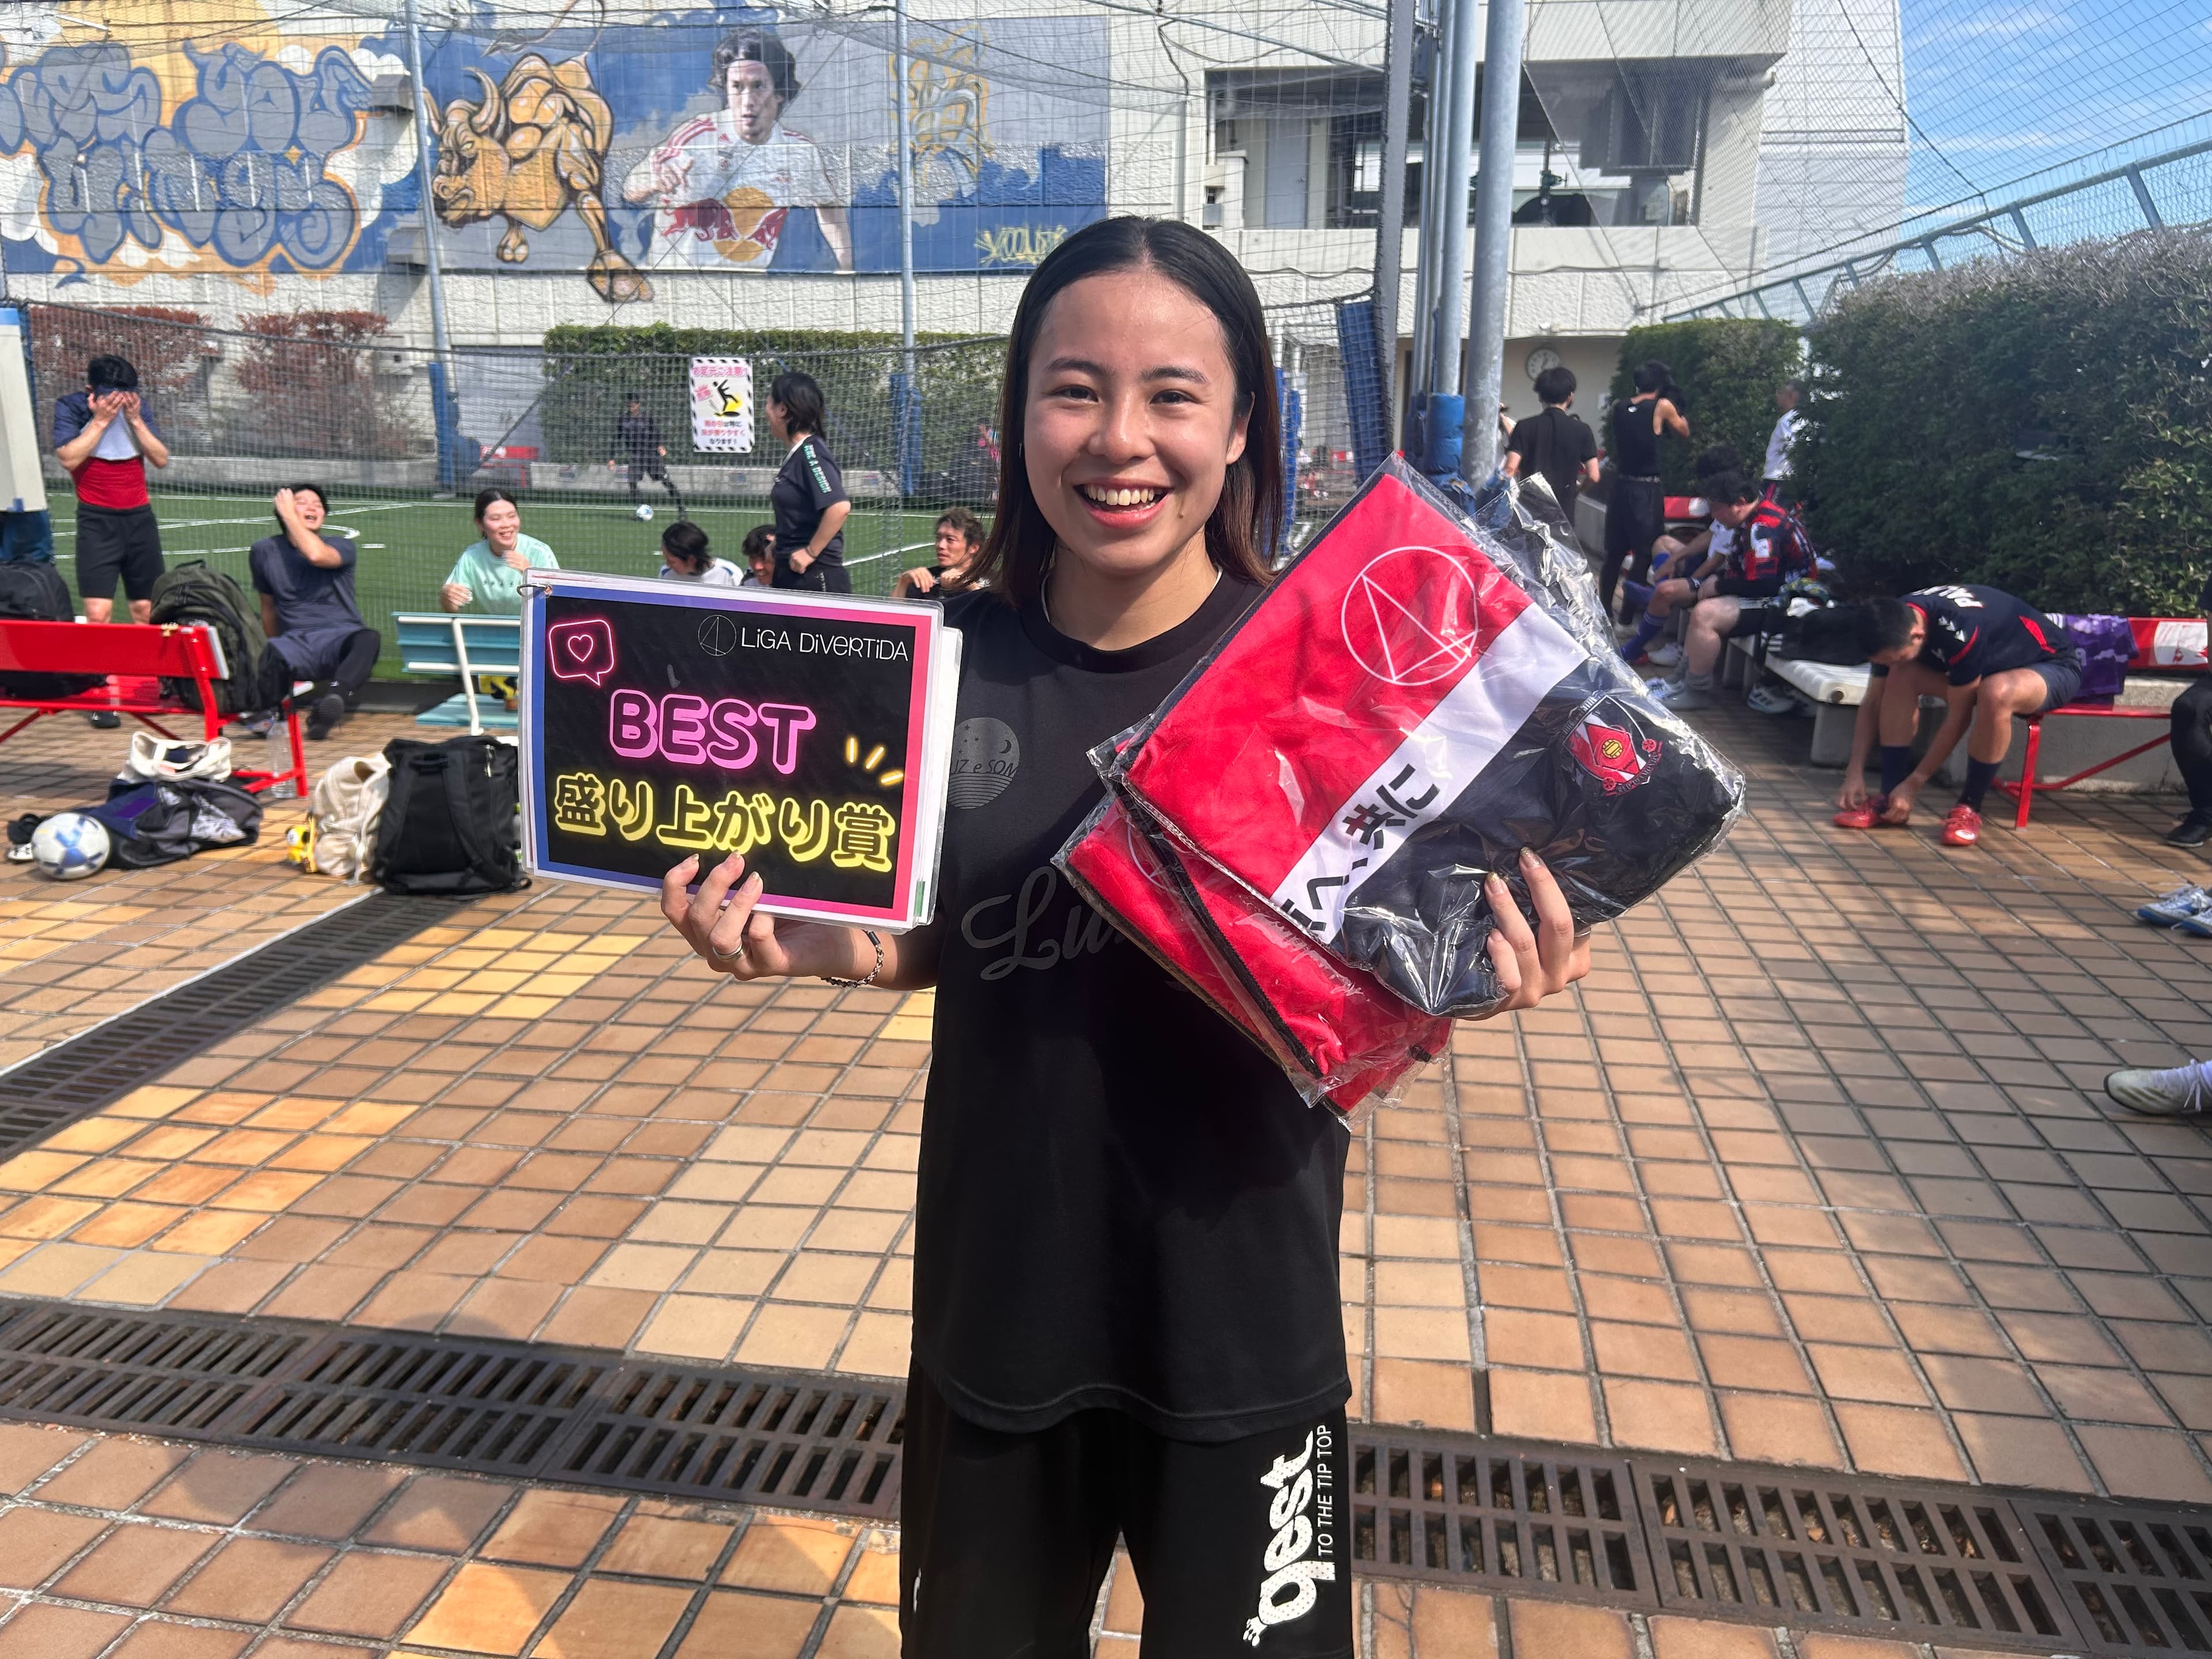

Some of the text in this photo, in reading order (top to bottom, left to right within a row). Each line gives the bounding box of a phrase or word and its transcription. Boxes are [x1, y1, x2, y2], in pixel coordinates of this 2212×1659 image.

[608, 688, 816, 775] BEST
[554, 771, 896, 873] 盛り上がり賞
[1316, 1424, 1334, 1556] TO THE TIP TOP
